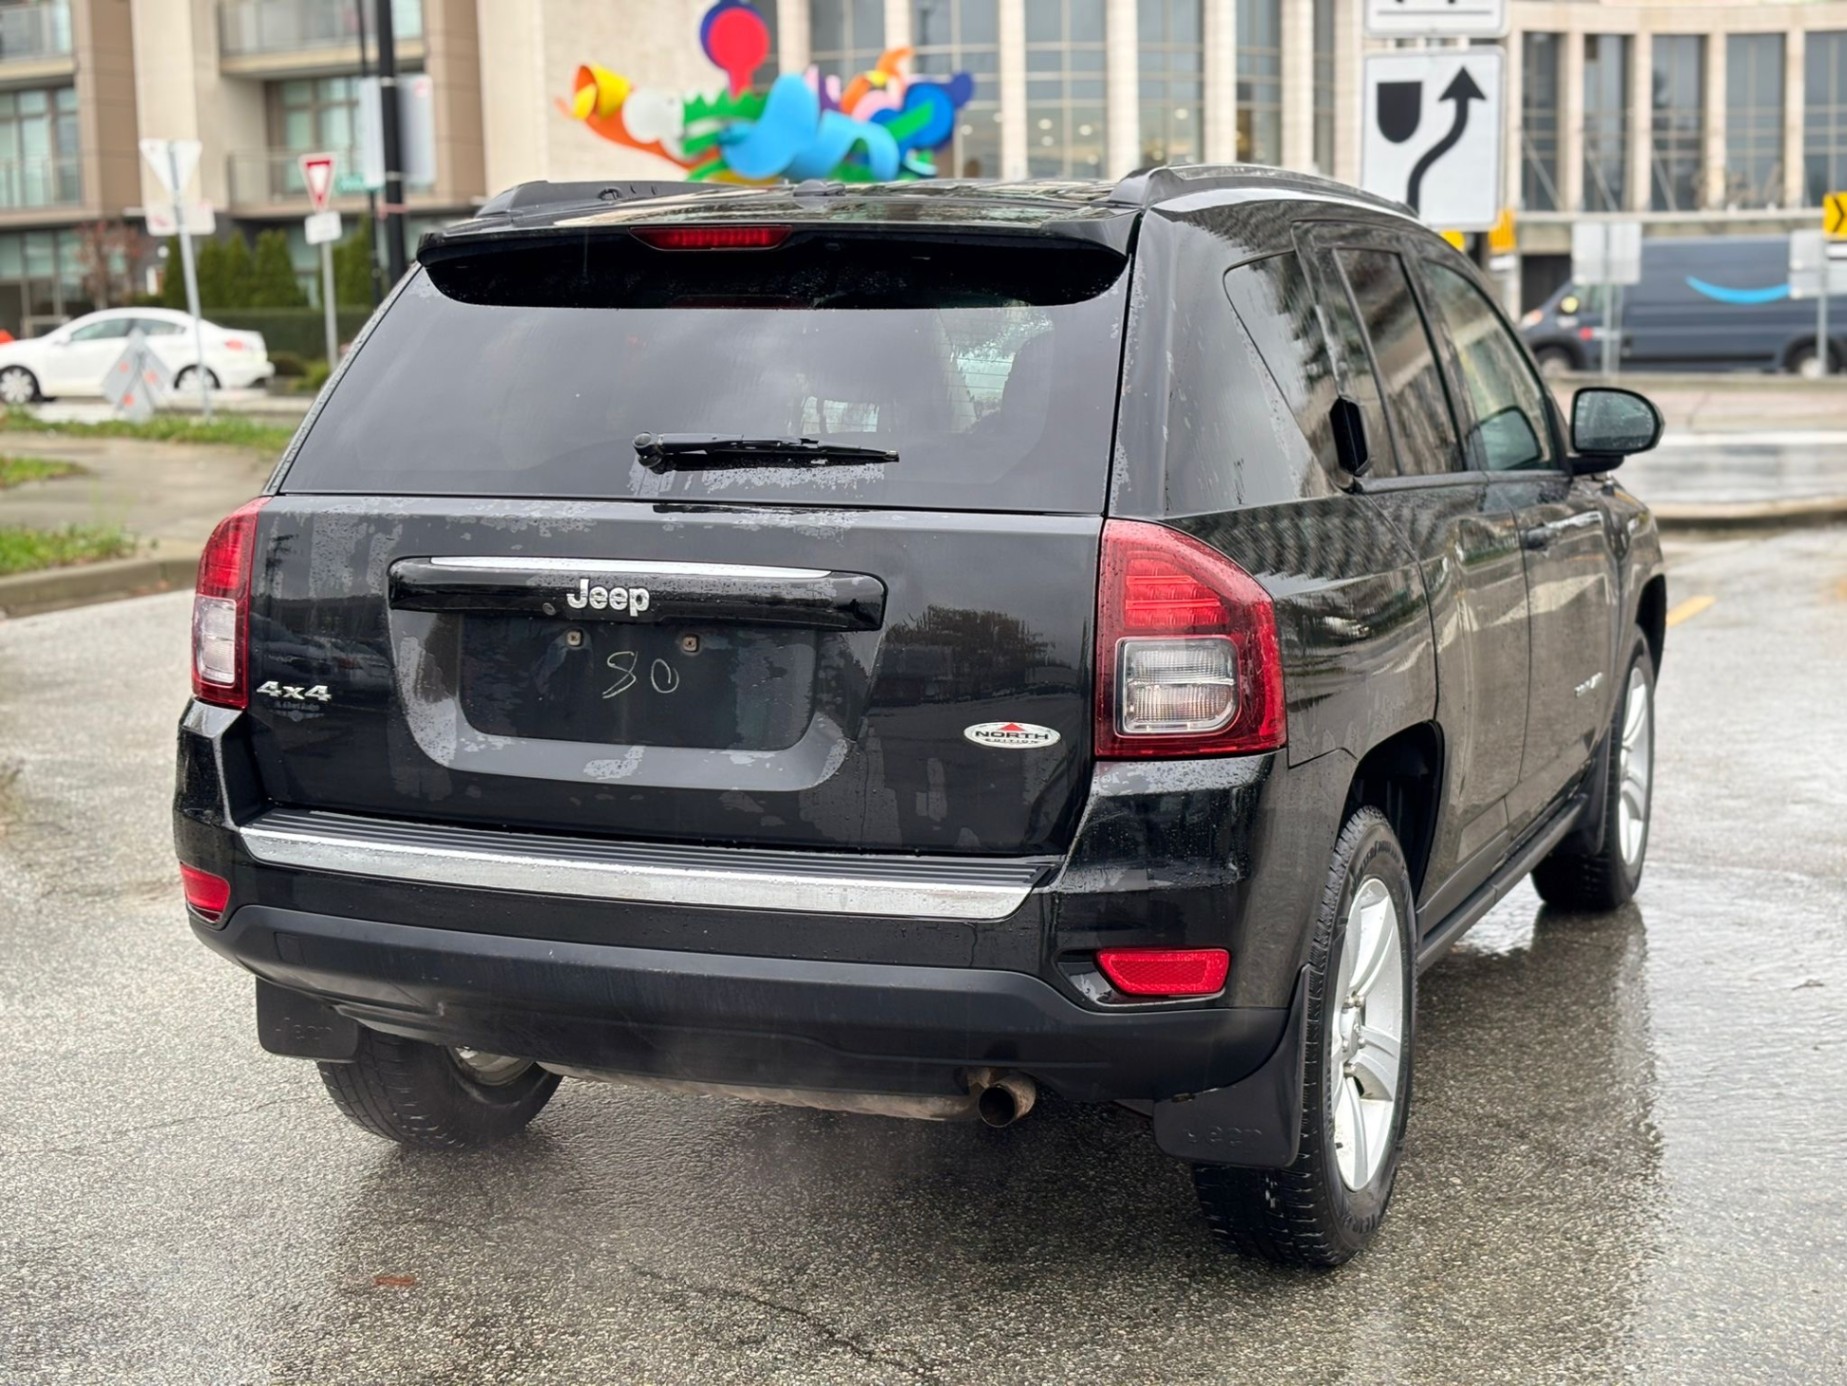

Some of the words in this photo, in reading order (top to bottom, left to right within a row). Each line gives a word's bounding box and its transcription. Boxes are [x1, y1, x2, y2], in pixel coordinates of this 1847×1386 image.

[566, 578, 650, 617] Jeep
[256, 680, 332, 701] 4x4
[975, 731, 1049, 740] NORTH
